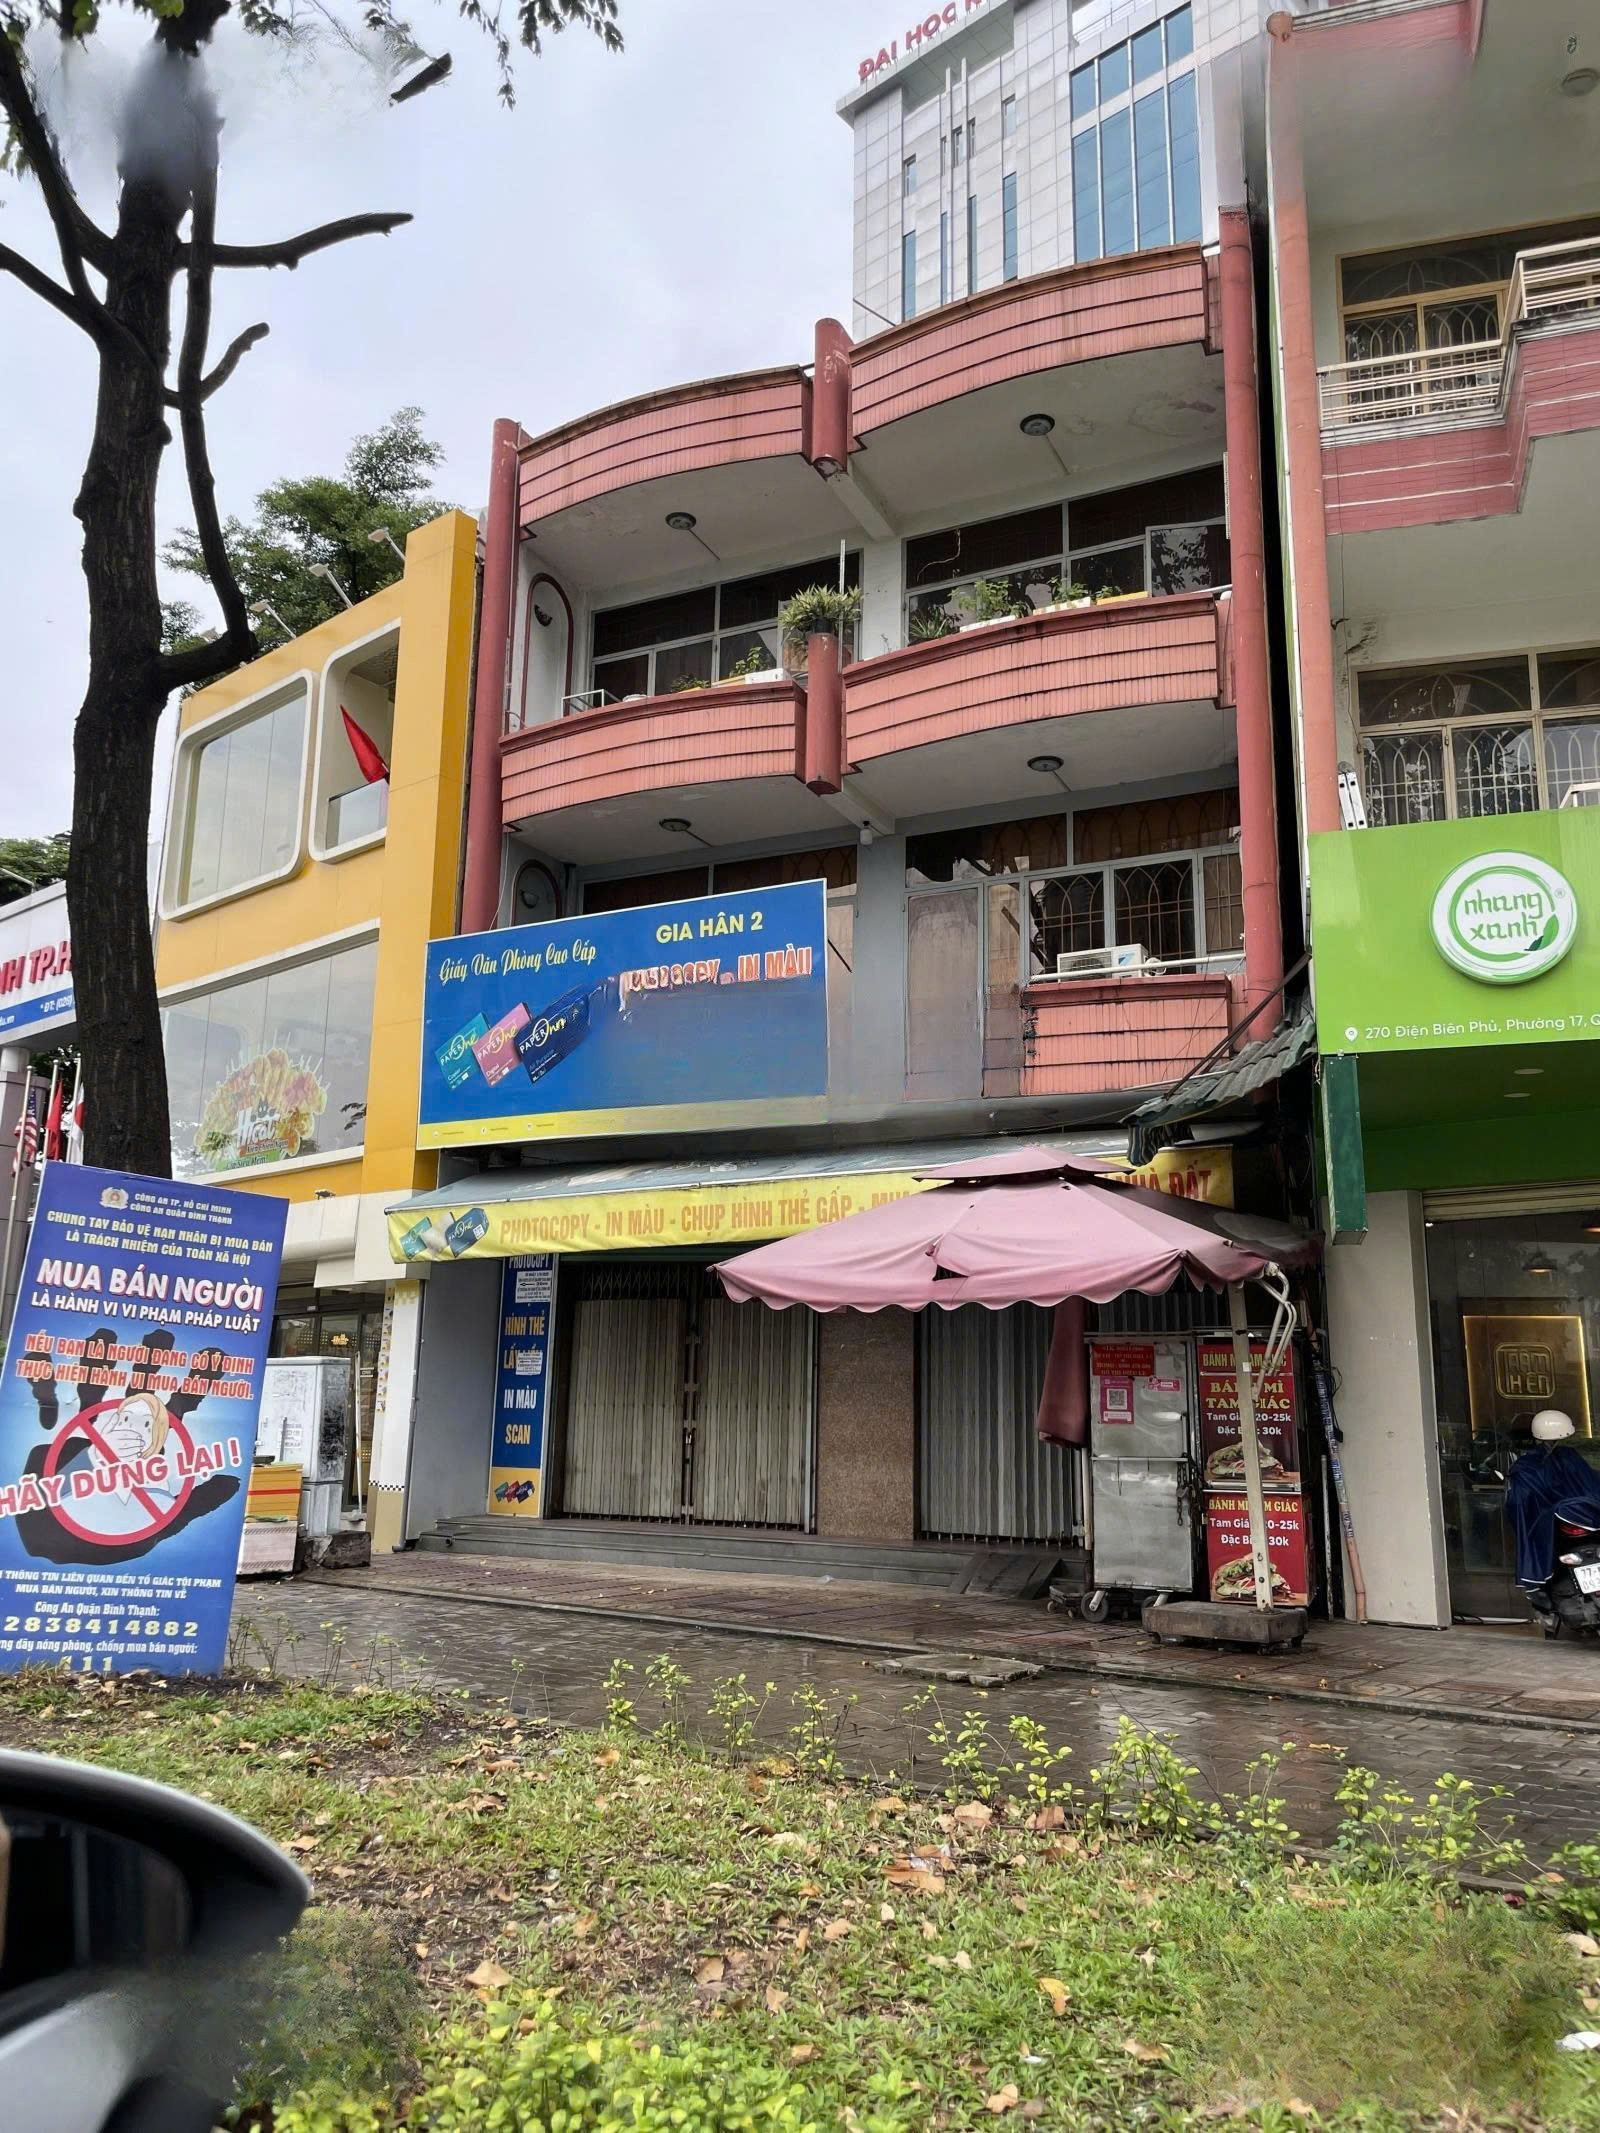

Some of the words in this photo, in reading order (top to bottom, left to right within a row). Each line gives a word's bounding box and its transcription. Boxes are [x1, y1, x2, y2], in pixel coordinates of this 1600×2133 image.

[655, 921, 694, 944] GIA
[699, 911, 744, 938] HÂN
[750, 911, 763, 931] 2
[439, 957, 468, 987] Giấy
[471, 953, 497, 976] Văn
[500, 948, 543, 977] Phòng
[545, 942, 568, 966] Cao
[572, 938, 598, 966] Cấp
[1365, 1026, 1391, 1039] 270
[1395, 1024, 1429, 1040] Điện
[1432, 1022, 1465, 1035] Biên
[1469, 1019, 1502, 1033] Phủ,
[1506, 1017, 1565, 1030] Phường
[1568, 1014, 1588, 1028] 17,
[130, 1203, 152, 1213] CÔNG
[153, 1206, 164, 1215] AN
[208, 1214, 233, 1225] THẠNH
[134, 1193, 156, 1204] CÔNG
[158, 1196, 169, 1205] AN
[170, 1198, 182, 1208] TP.
[211, 1204, 232, 1215] MINH
[499, 1213, 590, 1244] PHOTOCOPY
[605, 1211, 623, 1237] IN
[628, 1203, 665, 1236] MÀU
[680, 1203, 726, 1237] CHỤP
[731, 1196, 773, 1229] HÌNH
[778, 1189, 811, 1225] THẺ
[815, 1185, 853, 1224] GẤP
[47, 1210, 87, 1227] CHUNG
[89, 1216, 110, 1230] TAY
[112, 1218, 135, 1234] BẢO
[137, 1223, 152, 1238] VỆ
[153, 1225, 176, 1242] NẠN
[178, 1230, 208, 1244] NHÂN
[210, 1234, 222, 1249] BỊ
[224, 1236, 249, 1250] MUA
[251, 1238, 274, 1253] BÁN
[65, 1229, 80, 1243] LÀ
[83, 1232, 120, 1249] TRÁCH
[121, 1238, 159, 1254] NHIỆM
[161, 1242, 183, 1257] CỦA
[185, 1247, 213, 1262] TOÀN
[215, 1250, 230, 1263] XÃ
[232, 1253, 251, 1268] HỘI
[509, 1254, 550, 1270] PHOTOCOPY
[36, 1258, 102, 1292] MUA
[108, 1263, 170, 1300] BÁN
[173, 1276, 263, 1312] NGƯỜI
[31, 1291, 51, 1308] LÀ
[54, 1292, 99, 1314] HÀNH
[103, 1300, 119, 1317] VI
[122, 1303, 138, 1320] VI
[139, 1305, 182, 1326] PHẠM
[184, 1308, 223, 1329] PHÁP
[225, 1313, 261, 1335] LUẬT
[504, 1311, 527, 1336] HÌNH
[528, 1308, 546, 1336] THẺ
[25, 1329, 54, 1354] NẾU
[56, 1337, 86, 1357] BẠN
[87, 1338, 105, 1359] LÀ
[106, 1341, 150, 1365] NGƯỜI
[151, 1348, 187, 1367] ĐANG
[190, 1347, 209, 1370] CÓ
[210, 1349, 223, 1371] Ý
[222, 1356, 255, 1376] ĐỊNH
[1202, 1350, 1228, 1367] BÁNH
[15, 1358, 53, 1381] THỰC
[54, 1361, 89, 1384] HIỆN
[89, 1364, 127, 1387] HÀNH
[130, 1374, 145, 1390] VI
[148, 1375, 178, 1392] MUA
[180, 1373, 209, 1395] BÁN
[209, 1378, 254, 1400] NGƯỜI.
[1263, 1379, 1285, 1393] MÌ
[504, 1389, 515, 1409] IN
[515, 1384, 538, 1410] MÀU
[1206, 1397, 1240, 1409] TAM
[1206, 1412, 1228, 1421] Tam
[504, 1423, 531, 1445] SCAN
[1217, 1425, 1236, 1436] Đặc
[1262, 1426, 1282, 1436] 30k
[71, 1456, 169, 1500] DỪNG
[177, 1443, 224, 1478] LẠI
[230, 1438, 241, 1467] !
[1209, 1496, 1236, 1511] BÁNH
[1273, 1499, 1299, 1513] GIÁC
[1209, 1517, 1232, 1528] Tam
[1233, 1517, 1251, 1529] Giá
[1265, 1519, 1300, 1531] 0-25k
[1221, 1534, 1241, 1547] Đặc
[1268, 1535, 1290, 1547] 30k
[6, 1569, 40, 1580] THÔNG
[41, 1572, 60, 1581] TIN
[61, 1572, 85, 1583] LIÊN
[86, 1573, 114, 1584] QUAN
[115, 1573, 136, 1585] ĐẾN
[137, 1573, 152, 1585] TỐ
[152, 1575, 174, 1586] GIÁC
[176, 1577, 192, 1588] TỘI
[193, 1578, 222, 1589] PHẠM
[16, 1583, 39, 1593] MUA
[41, 1582, 63, 1594] BÁN
[101, 1587, 119, 1597] XIN
[121, 1587, 154, 1598] THÔNG
[156, 1589, 173, 1598] TIN
[174, 1587, 188, 1599] VỀ
[34, 1601, 60, 1615] Công
[61, 1602, 74, 1613] An
[76, 1602, 101, 1616] Quận
[102, 1603, 125, 1615] Bình
[127, 1605, 160, 1617] Thạnh:
[36, 1639, 60, 1653] nóng
[62, 1640, 94, 1653] phòng,
[96, 1639, 125, 1654] chống
[126, 1643, 148, 1653] mua
[149, 1642, 166, 1653] bán
[167, 1643, 199, 1656] người:
